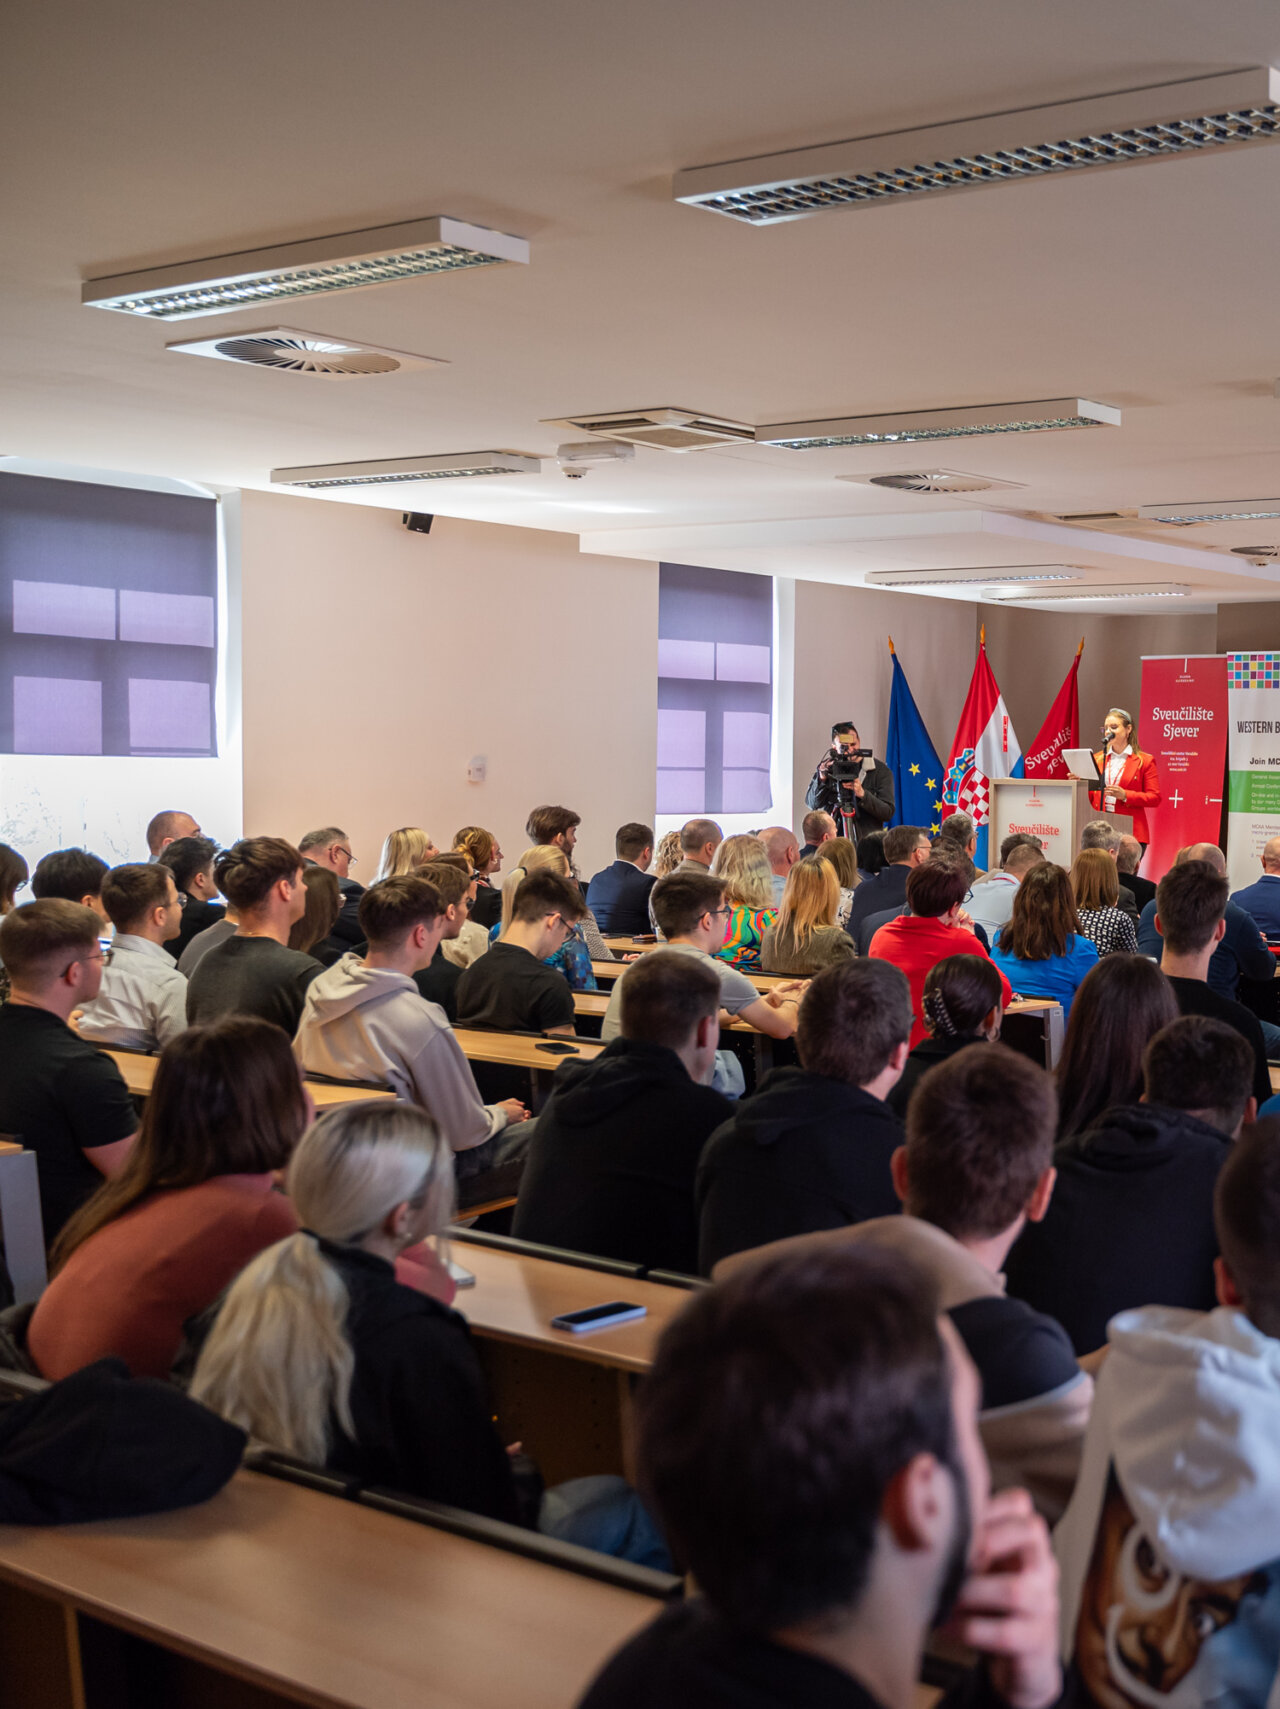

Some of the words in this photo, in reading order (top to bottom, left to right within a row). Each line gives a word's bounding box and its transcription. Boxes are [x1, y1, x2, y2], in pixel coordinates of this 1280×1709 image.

[1152, 706, 1214, 721] Sveučilište
[1163, 723, 1200, 741] Sjever
[1237, 721, 1273, 733] WESTERN
[1249, 757, 1266, 766] Join
[1008, 823, 1060, 836] Sveučilište
